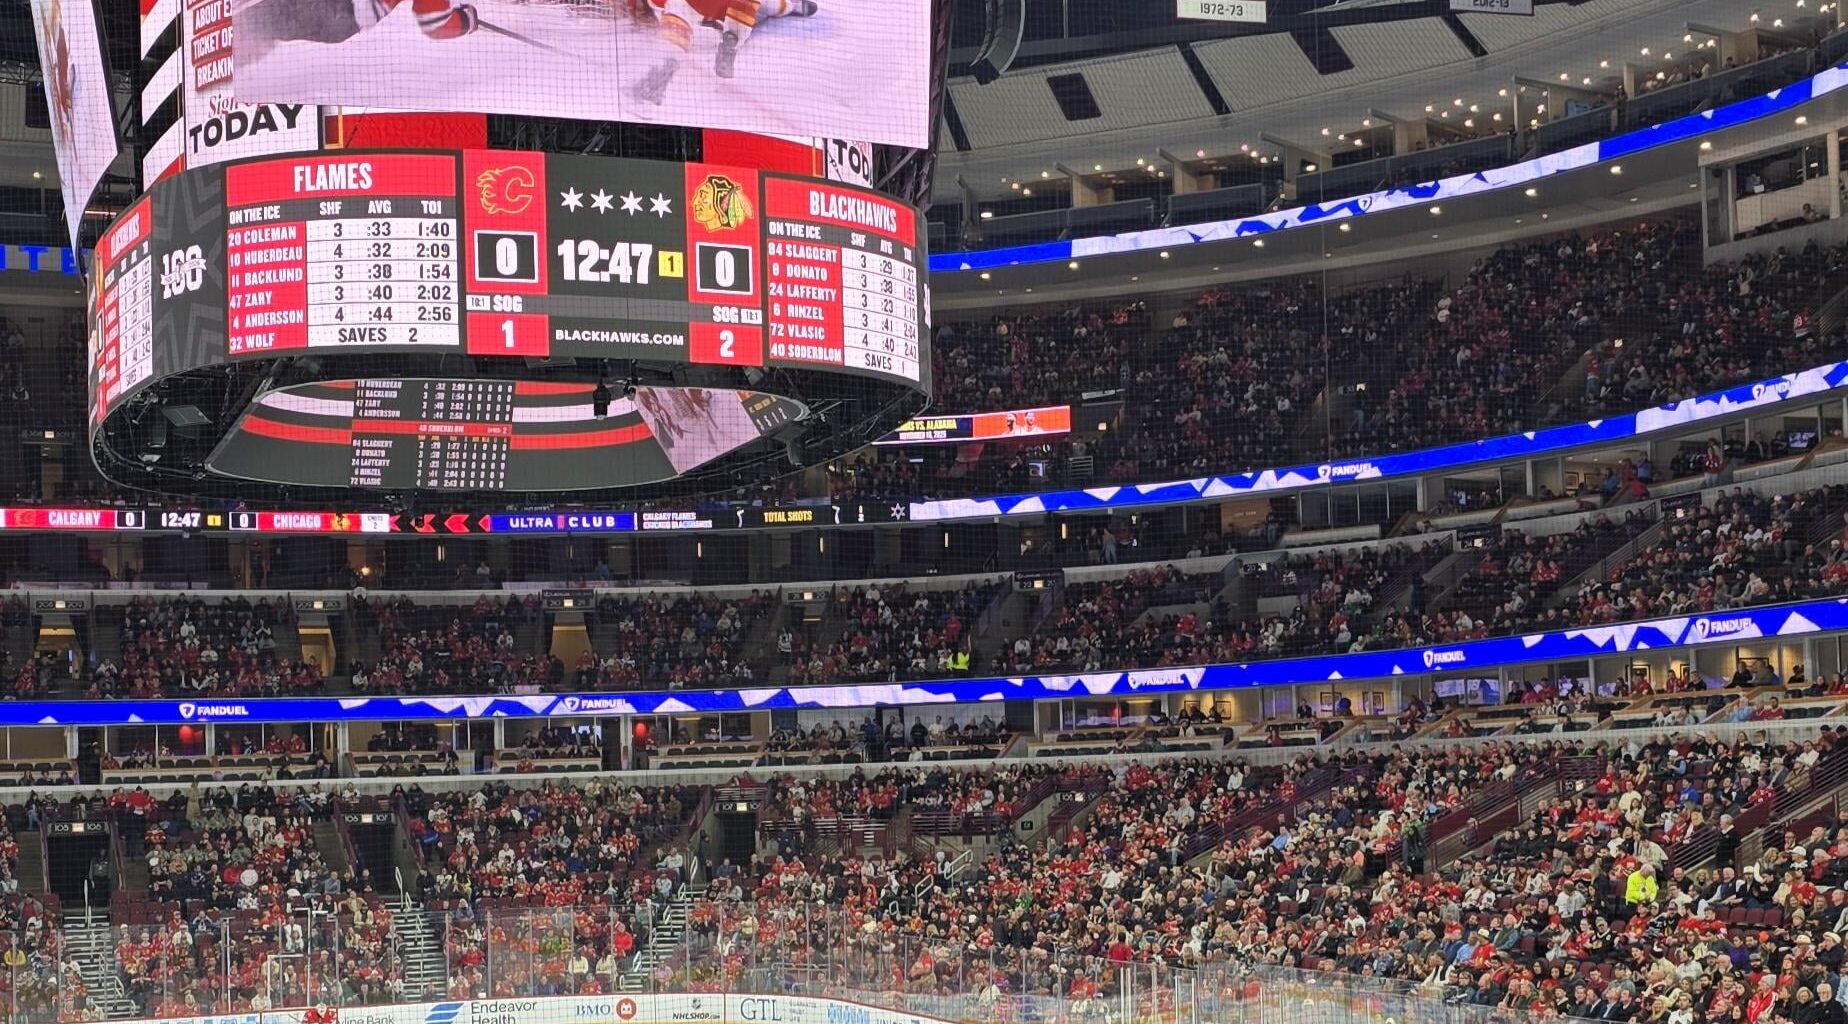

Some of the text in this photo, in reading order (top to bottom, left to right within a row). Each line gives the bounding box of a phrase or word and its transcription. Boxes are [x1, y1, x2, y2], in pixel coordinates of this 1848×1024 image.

[195, 1, 222, 30] ABOUT
[1200, 2, 1244, 16] 1972-73
[193, 30, 220, 60] TICKET
[189, 104, 304, 154] TODAY
[832, 138, 872, 186] TOD
[294, 162, 372, 192] FLAMES
[230, 200, 442, 224] ON THE ICE SHF AVG TOI
[810, 190, 897, 233] BLACKHAWKS
[228, 222, 450, 248] 20 COLEMAN 3 :33 1:40
[768, 221, 784, 236] ON
[784, 223, 806, 238] THE
[806, 226, 822, 240] ICE
[850, 232, 866, 248] SHF
[230, 242, 450, 267] 10 HUBERDEAU 4 :32 2:09
[495, 238, 518, 276] 0
[557, 238, 676, 284] 12:47 1
[768, 242, 783, 256] 84
[786, 243, 838, 263] SLAGGERT
[860, 254, 867, 269] 3
[880, 260, 893, 276] :29
[232, 264, 450, 287] 11 BACKLUND 3 :38 1:54
[714, 250, 735, 288] 0
[772, 262, 780, 277] 8
[786, 264, 828, 282] DONATO
[860, 274, 868, 288] 3
[229, 284, 452, 309] 47 ZARY 3 :40 2:02
[492, 294, 522, 312] SOG
[769, 282, 784, 296] 24
[786, 284, 838, 302] LAFFERTY
[861, 294, 868, 308] 3
[881, 298, 894, 314] :23
[232, 306, 452, 330] 4 ANDERSSON 4 :44 2:56
[712, 306, 738, 324] SOG
[773, 303, 780, 317] 6
[788, 305, 824, 320] RINZEL
[862, 313, 868, 328] 3
[230, 326, 418, 351] 32 WOLF SAVES 2
[502, 320, 514, 348] 1
[555, 328, 684, 346] BLACKHAWKS.COM
[719, 330, 734, 358] 2
[770, 322, 895, 352] 72 VLASIC 4 :40
[770, 342, 785, 356] 40
[864, 352, 892, 370] SAVES
[48, 512, 100, 527] CALGARY
[126, 514, 135, 526] 0
[162, 512, 200, 528] 12:47
[239, 514, 248, 528] 0
[273, 514, 320, 528] CHICAGO
[509, 516, 616, 528] ULTRA CLUB
[763, 510, 813, 523] TOTAL SHOTS
[197, 706, 249, 716] FANDUEL
[367, 1014, 394, 1024] Bank
[470, 1001, 538, 1014] Endeavor
[470, 1014, 516, 1024] Health
[576, 1004, 611, 1016] BMO
[740, 998, 782, 1022] GTL
